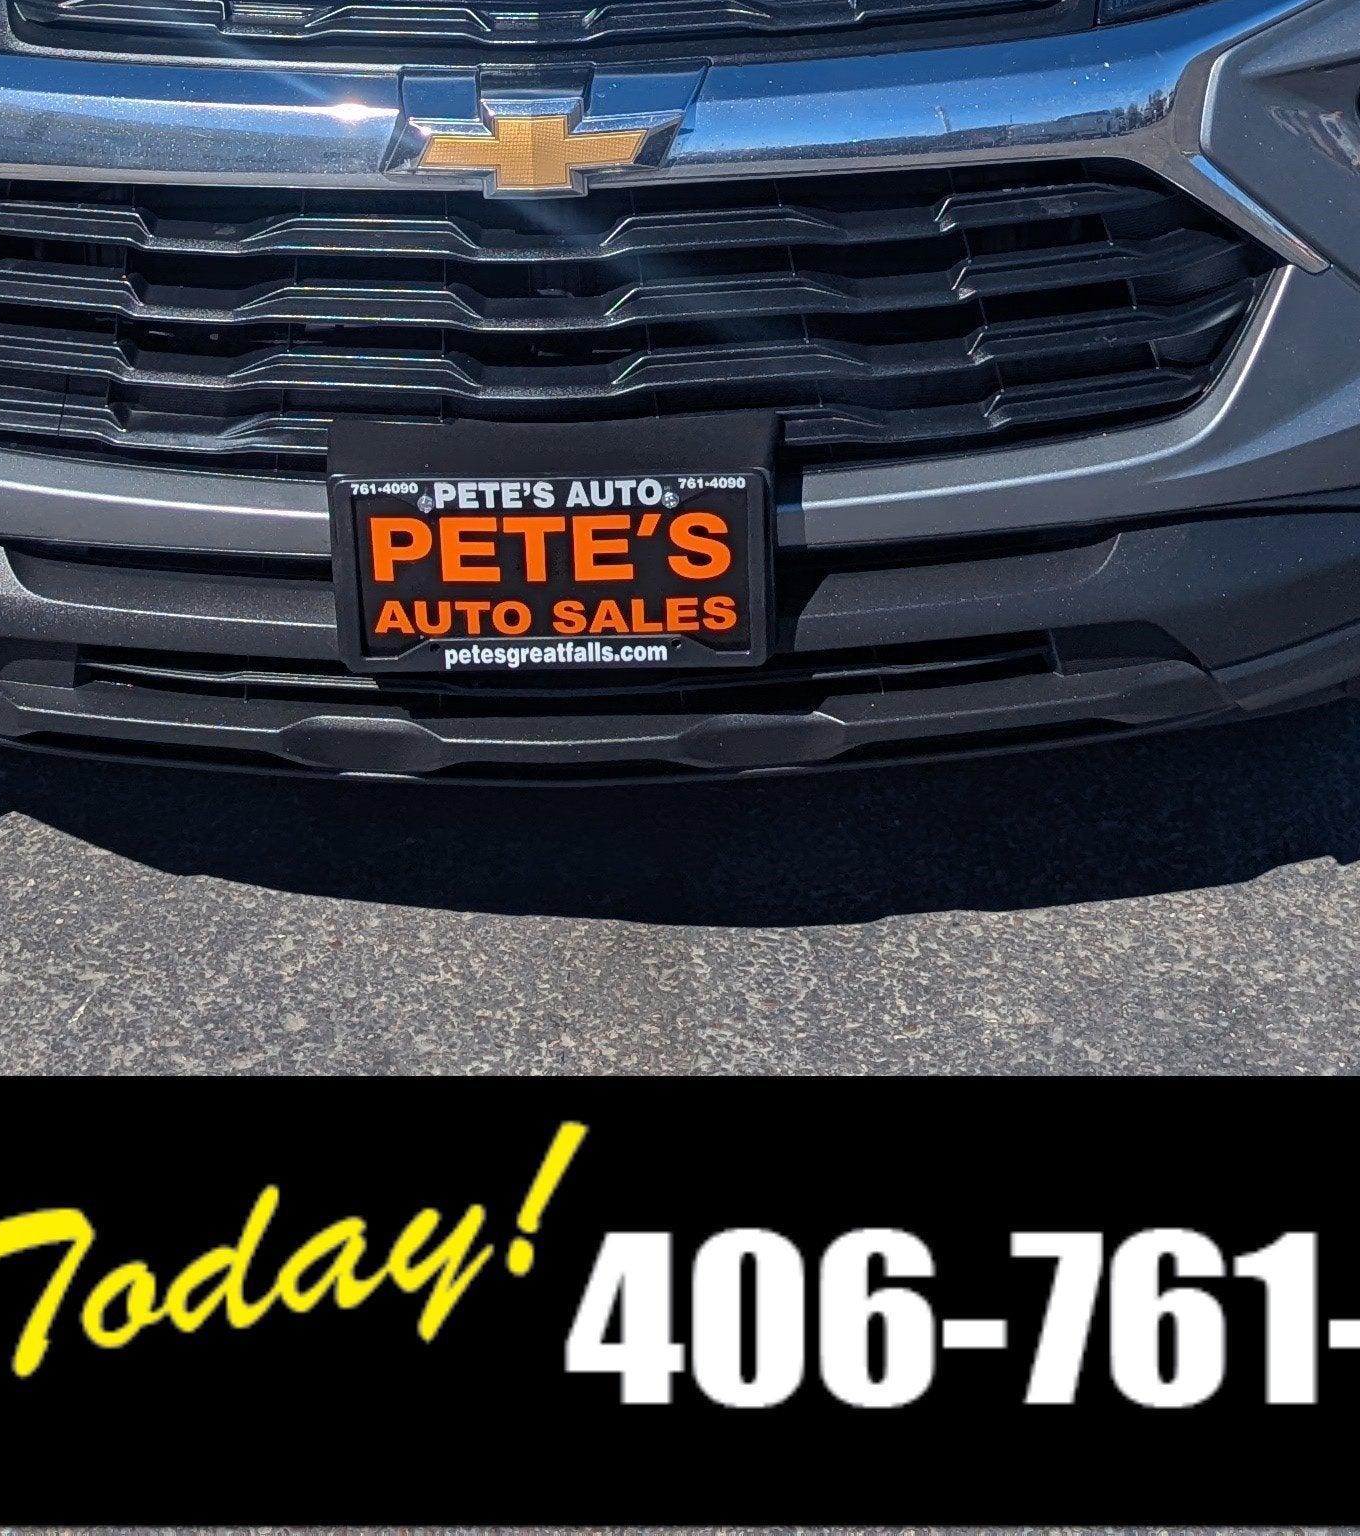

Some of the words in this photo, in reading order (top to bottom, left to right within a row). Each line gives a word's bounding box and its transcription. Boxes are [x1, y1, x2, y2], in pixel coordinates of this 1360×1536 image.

[433, 481, 555, 509] PETE'S
[565, 478, 663, 508] AUTO
[369, 512, 732, 583] PETE'S
[374, 599, 533, 636] AUTO
[552, 595, 737, 634] SALES
[444, 641, 669, 670] petesgreatfalls.com
